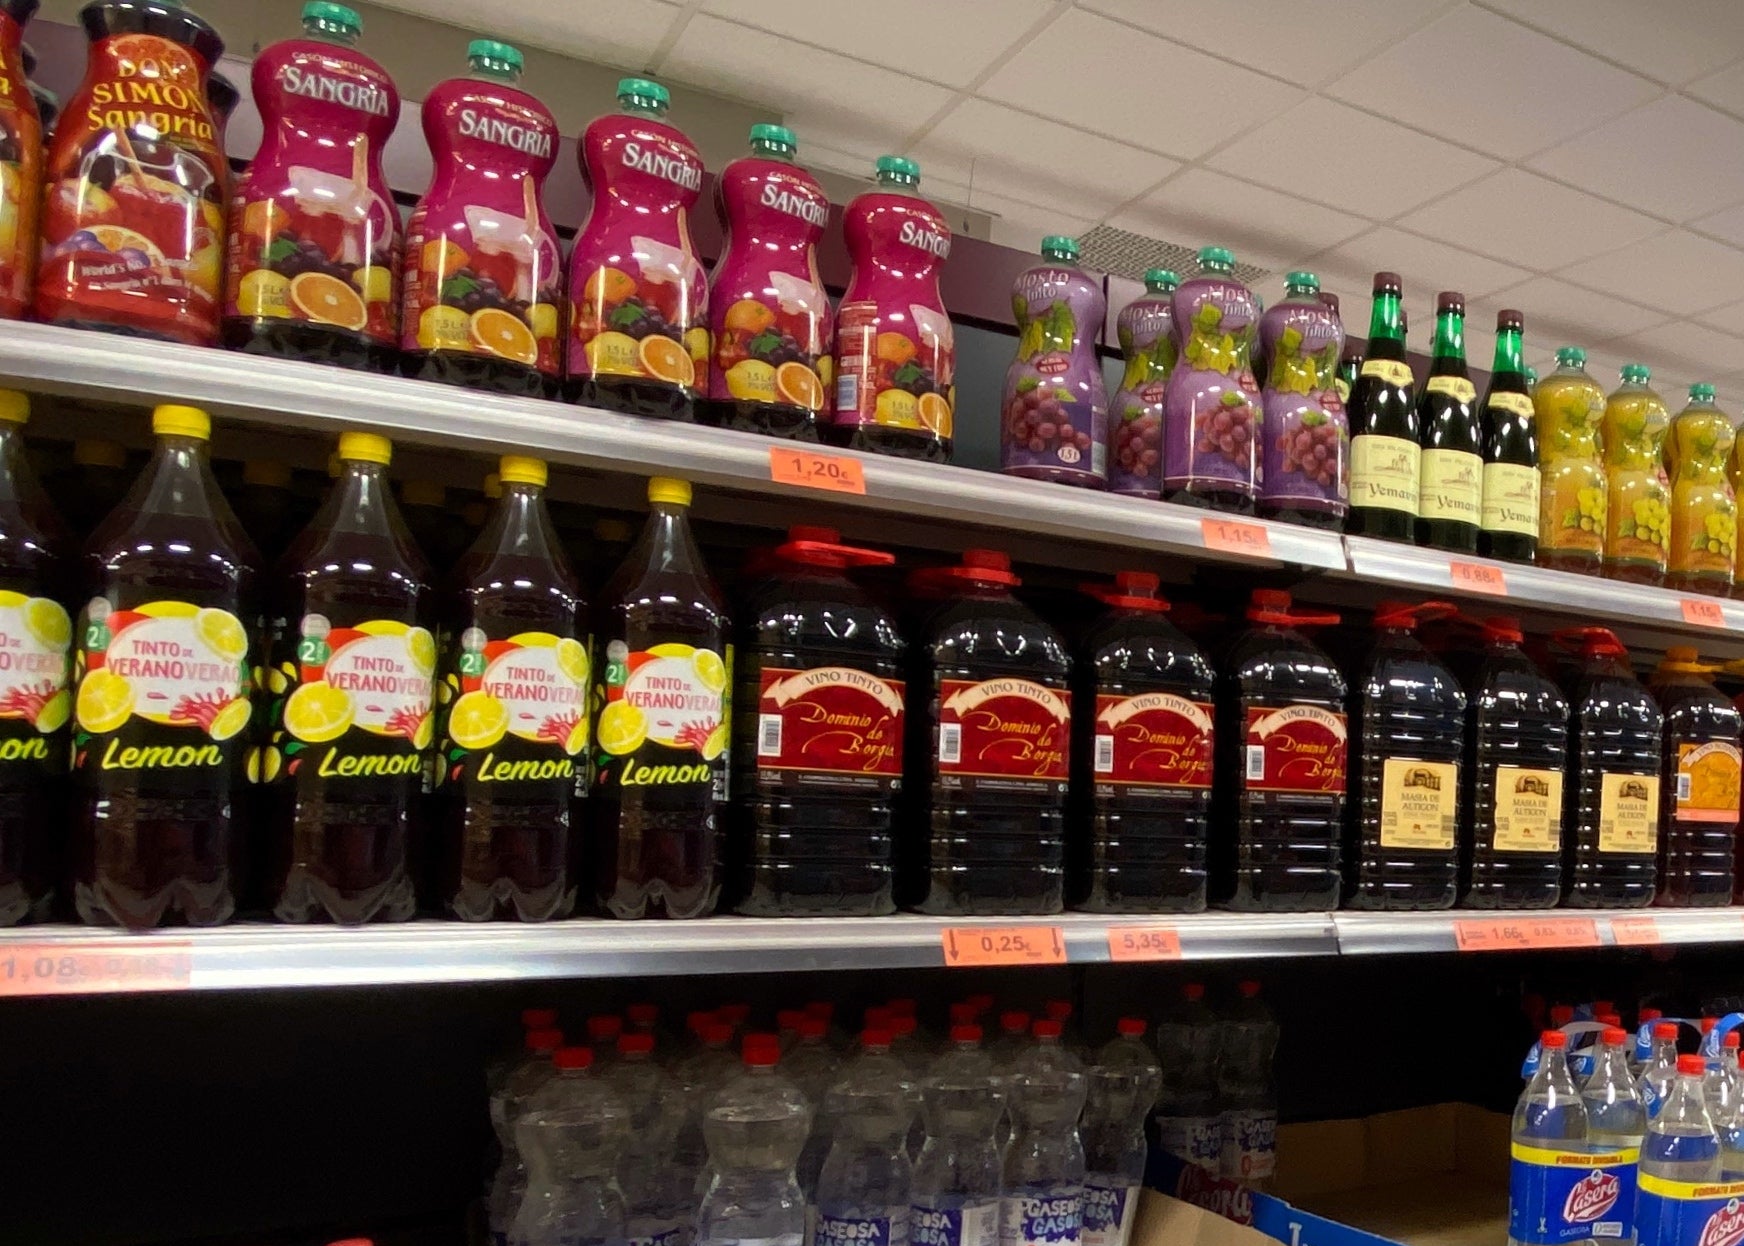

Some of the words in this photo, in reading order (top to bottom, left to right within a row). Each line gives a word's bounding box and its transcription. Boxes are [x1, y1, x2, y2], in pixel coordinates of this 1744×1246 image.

[283, 66, 389, 117] SANGRIA
[459, 109, 552, 160] SANGRIA
[132, 639, 180, 659] TINTO
[108, 658, 184, 681] VERANO
[353, 656, 395, 673] TINTO
[507, 667, 545, 682] TINTO
[327, 672, 397, 694] VERANO
[484, 682, 548, 701] VERANO
[646, 676, 682, 691] TINTO
[805, 671, 841, 686] VINO
[845, 671, 884, 696] TINTO
[982, 682, 1013, 697] VINO
[1016, 682, 1052, 704] TINTO
[626, 691, 685, 709] VERANO
[787, 703, 872, 727] Dominio
[965, 711, 1042, 735] Dominio
[102, 737, 224, 770] Lemon
[318, 747, 421, 777] Lemon
[477, 752, 574, 782] Lemon
[620, 758, 712, 786] Lemon
[1563, 1180, 1621, 1223] Casera
